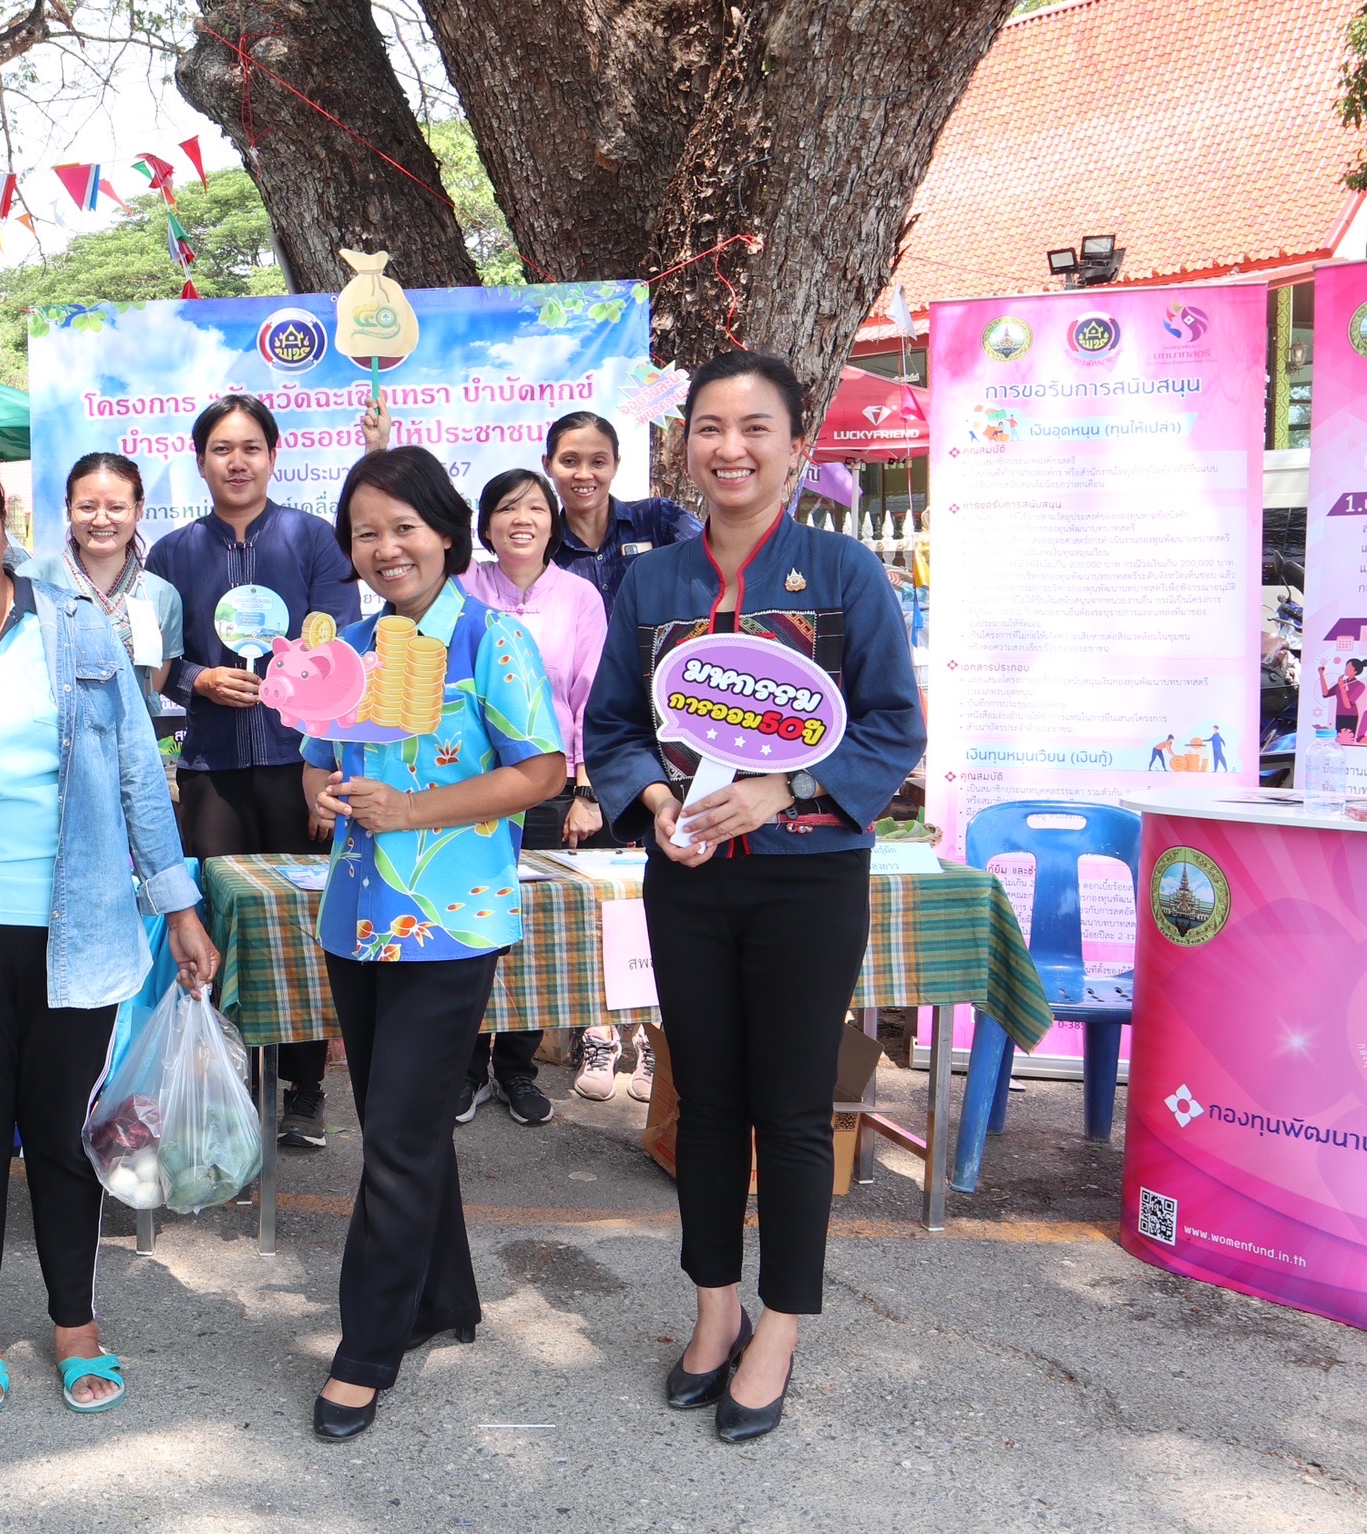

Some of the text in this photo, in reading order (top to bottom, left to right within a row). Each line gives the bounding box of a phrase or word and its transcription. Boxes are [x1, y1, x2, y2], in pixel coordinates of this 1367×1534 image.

[84, 393, 196, 417] โครงการ
[464, 374, 593, 407] บำบัดทุกข์
[985, 378, 1200, 399] การขอรับการสนับสนุน
[834, 429, 920, 440] LUCKYFRIEND
[1030, 420, 1181, 439] เงินอุดหนุน (ทุนให้เปล่า)
[275, 463, 350, 482] งบประมา
[961, 662, 1030, 672] เอกสารประกอบ
[682, 658, 823, 714] มหกรรม
[668, 692, 827, 747] การออม50ปี
[966, 748, 1113, 767] เงินทุนหมุนเวียน (เงินกู้)
[960, 771, 1003, 783] คุณสมบัติ
[872, 845, 897, 856] นธุ์ผัก
[999, 877, 1026, 888] ะไม่เกิน
[1081, 894, 1134, 906] รกองทุนพัฒนา
[1082, 905, 1135, 916] วกับการลดอัต
[1118, 932, 1123, 940] 2
[1183, 1225, 1307, 1268] www.womenfund.in.th
